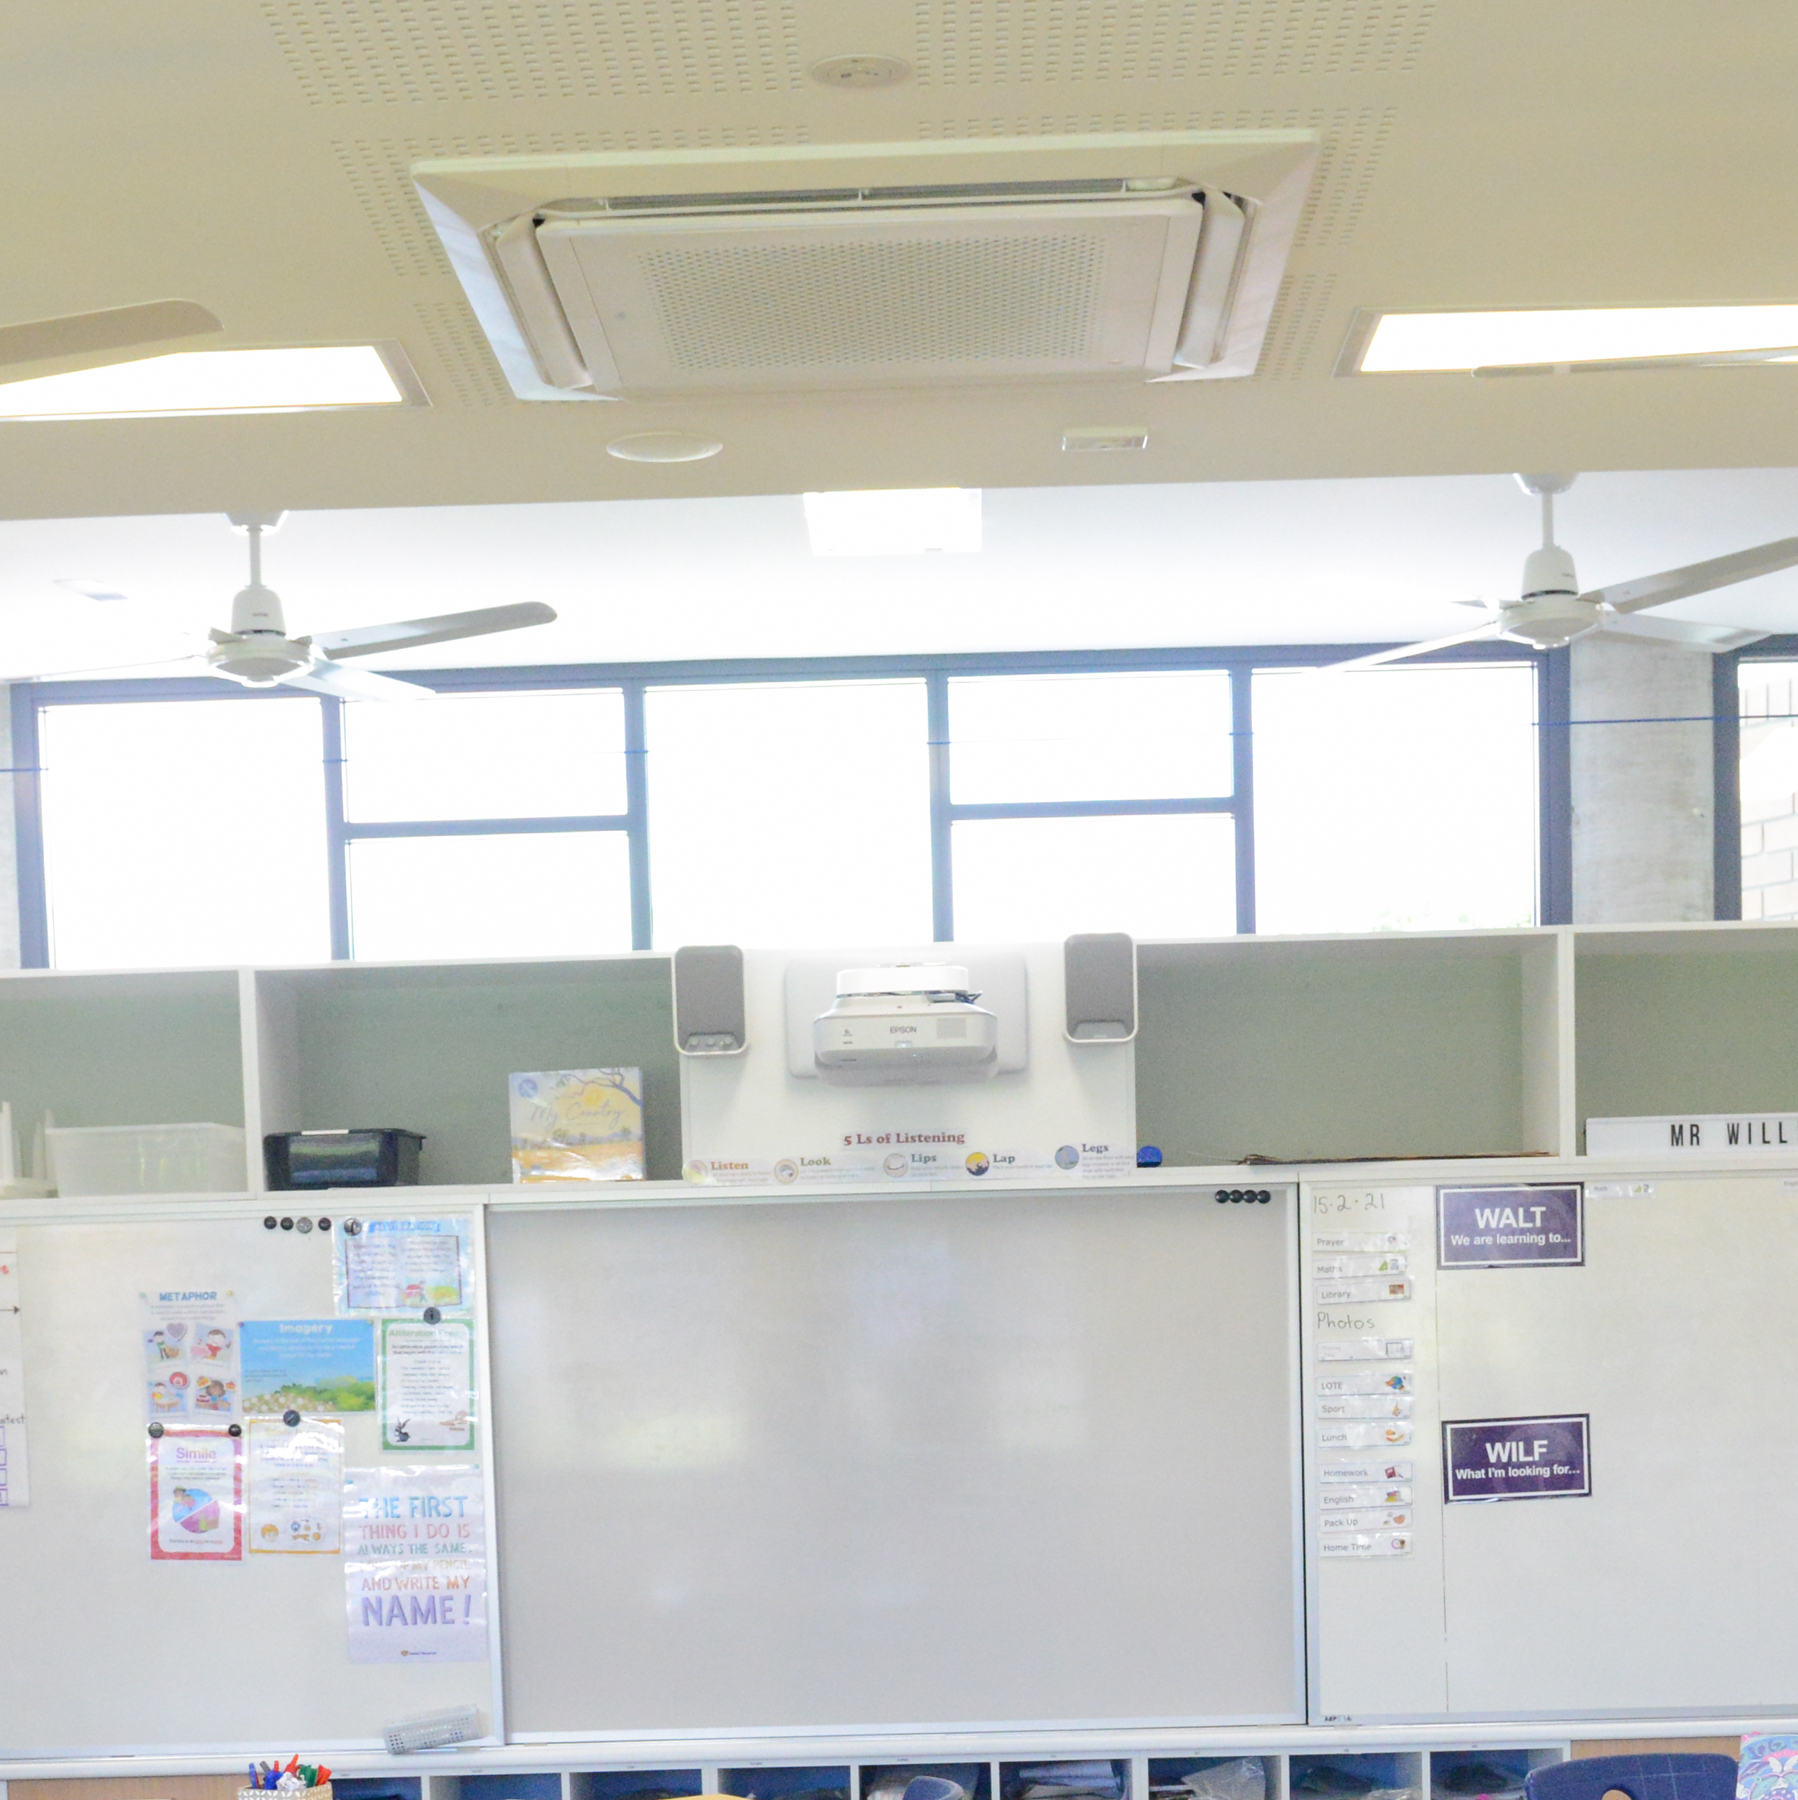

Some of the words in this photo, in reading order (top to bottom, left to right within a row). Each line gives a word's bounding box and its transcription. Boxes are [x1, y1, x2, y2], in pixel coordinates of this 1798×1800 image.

[889, 1026, 917, 1034] EPSON
[843, 1135, 853, 1146] 5
[856, 1134, 873, 1145] Ls
[876, 1134, 892, 1144] of
[895, 1131, 966, 1146] Listening
[1669, 1123, 1701, 1148] MR
[1081, 1143, 1110, 1154] Legs
[800, 1156, 832, 1167] Look
[910, 1153, 937, 1164] Lips
[992, 1153, 1016, 1165] Lap
[710, 1160, 749, 1171] Listen
[1474, 1206, 1547, 1230] WALT
[1316, 1237, 1345, 1248] Prayer
[1450, 1234, 1471, 1246] We
[1473, 1234, 1493, 1246] are
[1496, 1232, 1546, 1247] learning
[1548, 1232, 1572, 1244] to...
[158, 1290, 218, 1302] METAPHOR
[1321, 1289, 1351, 1300] Library
[1316, 1311, 1376, 1330] Photos
[279, 1322, 334, 1336] Imagery
[1321, 1381, 1343, 1391] LOTE
[1321, 1404, 1346, 1415] Sport
[1321, 1433, 1348, 1442] Lunch
[175, 1446, 217, 1461] Simile
[1484, 1439, 1549, 1464] WILF
[1323, 1468, 1370, 1478] Homework
[1455, 1467, 1486, 1480] What
[1487, 1467, 1506, 1479] I'm
[1508, 1465, 1551, 1479] looking
[1552, 1463, 1581, 1475] for...
[408, 1494, 469, 1518] FIRST
[1323, 1495, 1355, 1505] English
[1324, 1518, 1345, 1528] Pack
[1346, 1517, 1359, 1528] Up
[359, 1523, 408, 1540] THING
[426, 1523, 450, 1538] DO
[457, 1523, 471, 1539] IS
[357, 1543, 404, 1556] ALWAYS
[408, 1543, 428, 1555] THE
[434, 1542, 473, 1555] SAME.
[1323, 1543, 1349, 1552] Home
[1350, 1542, 1373, 1552] Time
[361, 1576, 393, 1591] AND
[393, 1575, 440, 1590] WRITE
[446, 1575, 471, 1590] MY
